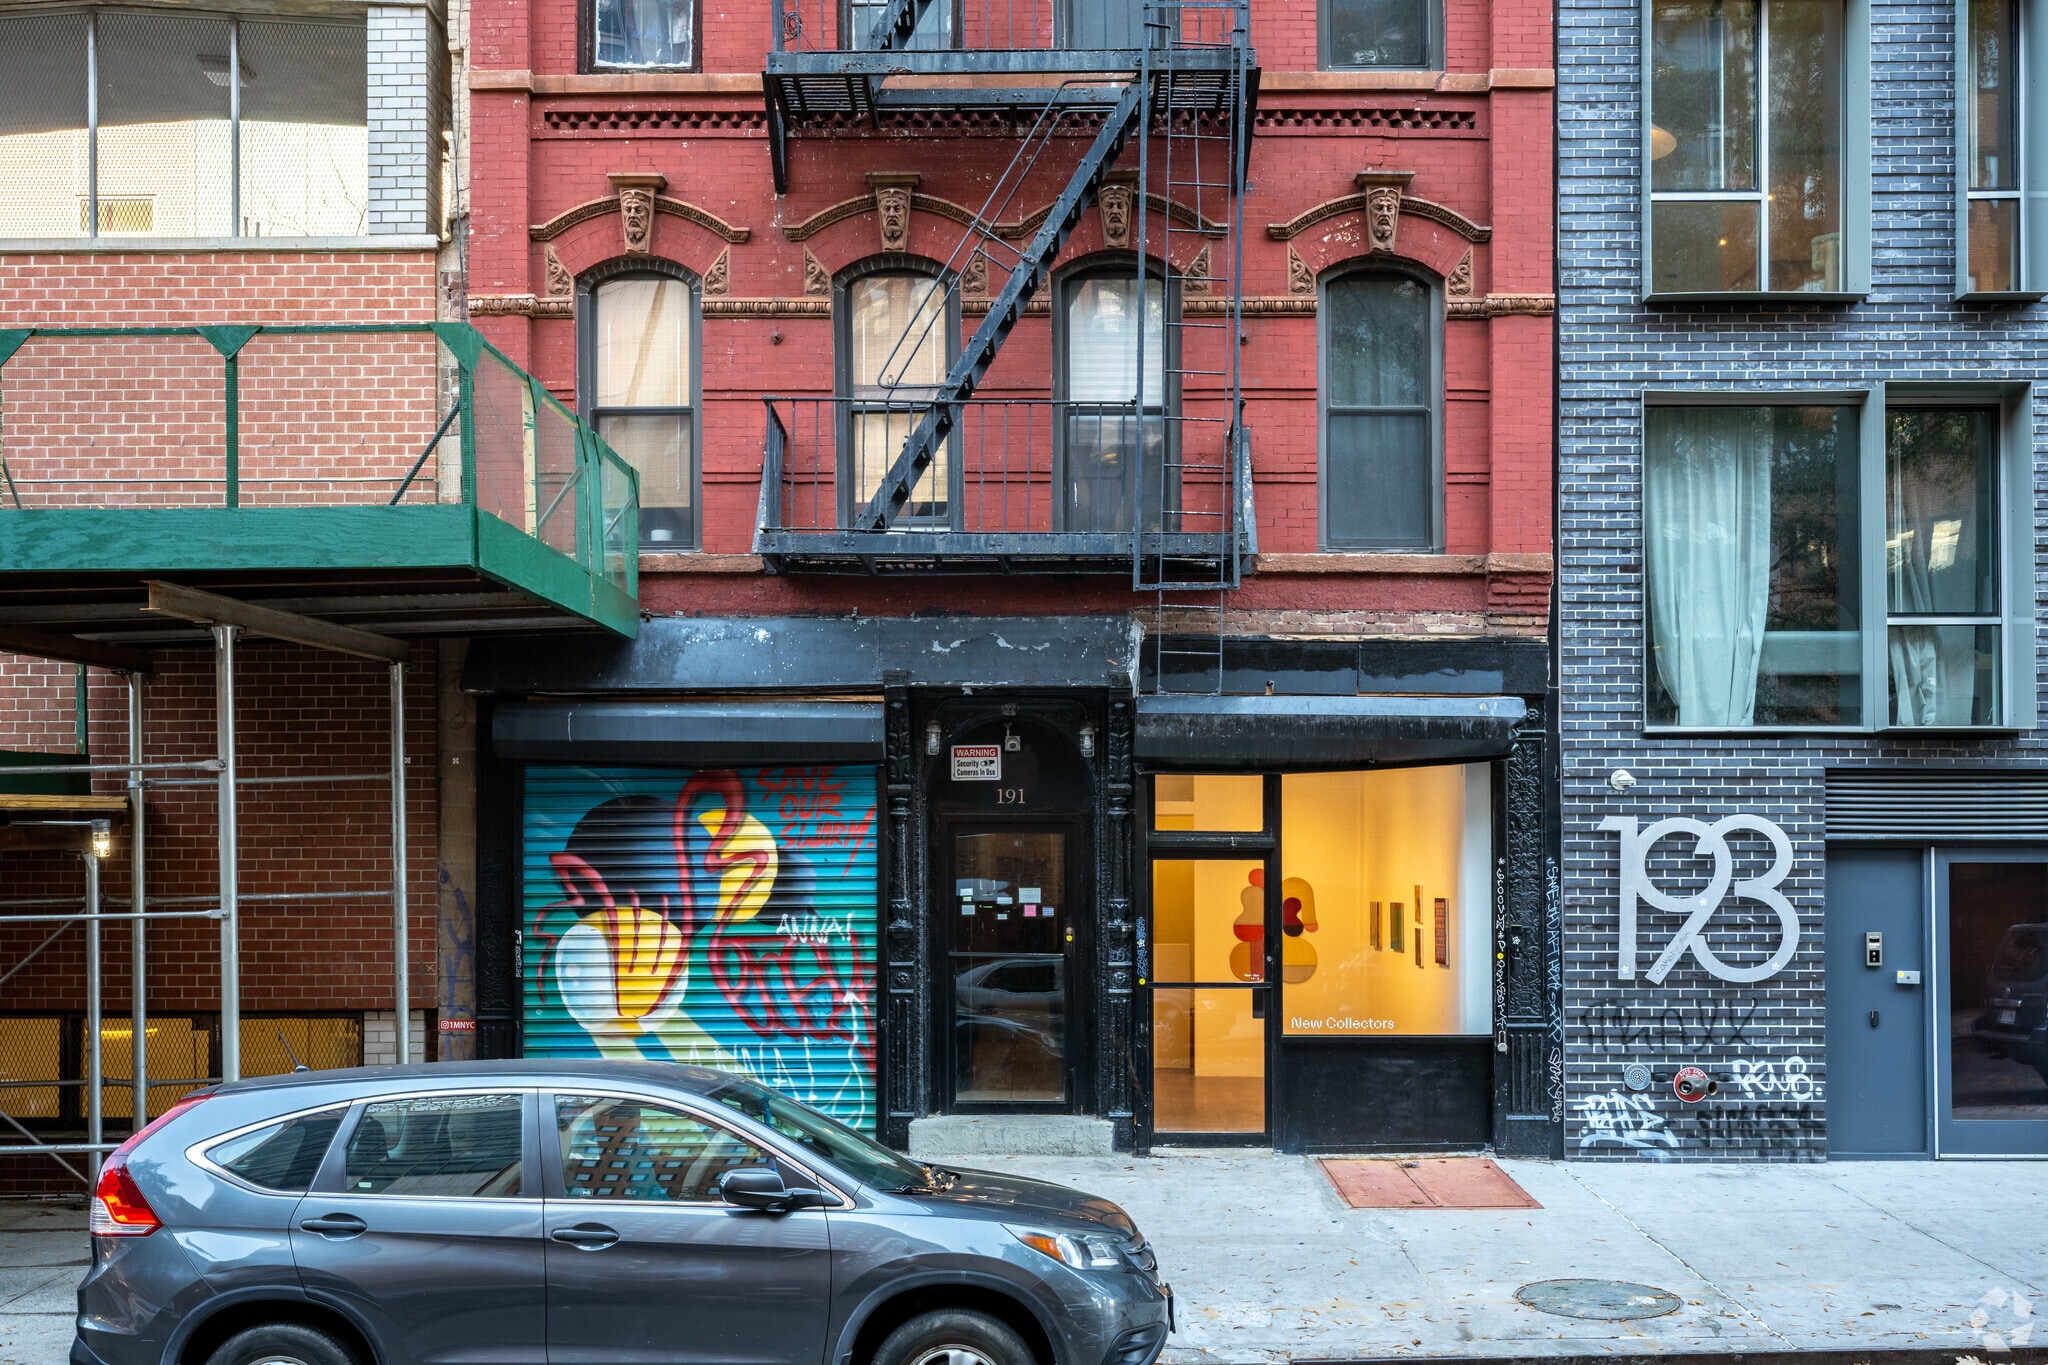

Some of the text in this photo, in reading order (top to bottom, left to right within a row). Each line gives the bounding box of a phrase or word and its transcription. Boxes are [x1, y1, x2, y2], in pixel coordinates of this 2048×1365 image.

[956, 749, 996, 757] WARNING
[957, 760, 979, 769] Security
[997, 789, 1026, 804] 191
[778, 793, 844, 819] OUR
[1596, 814, 1800, 986] 193
[1291, 1016, 1395, 1029] New Collectors
